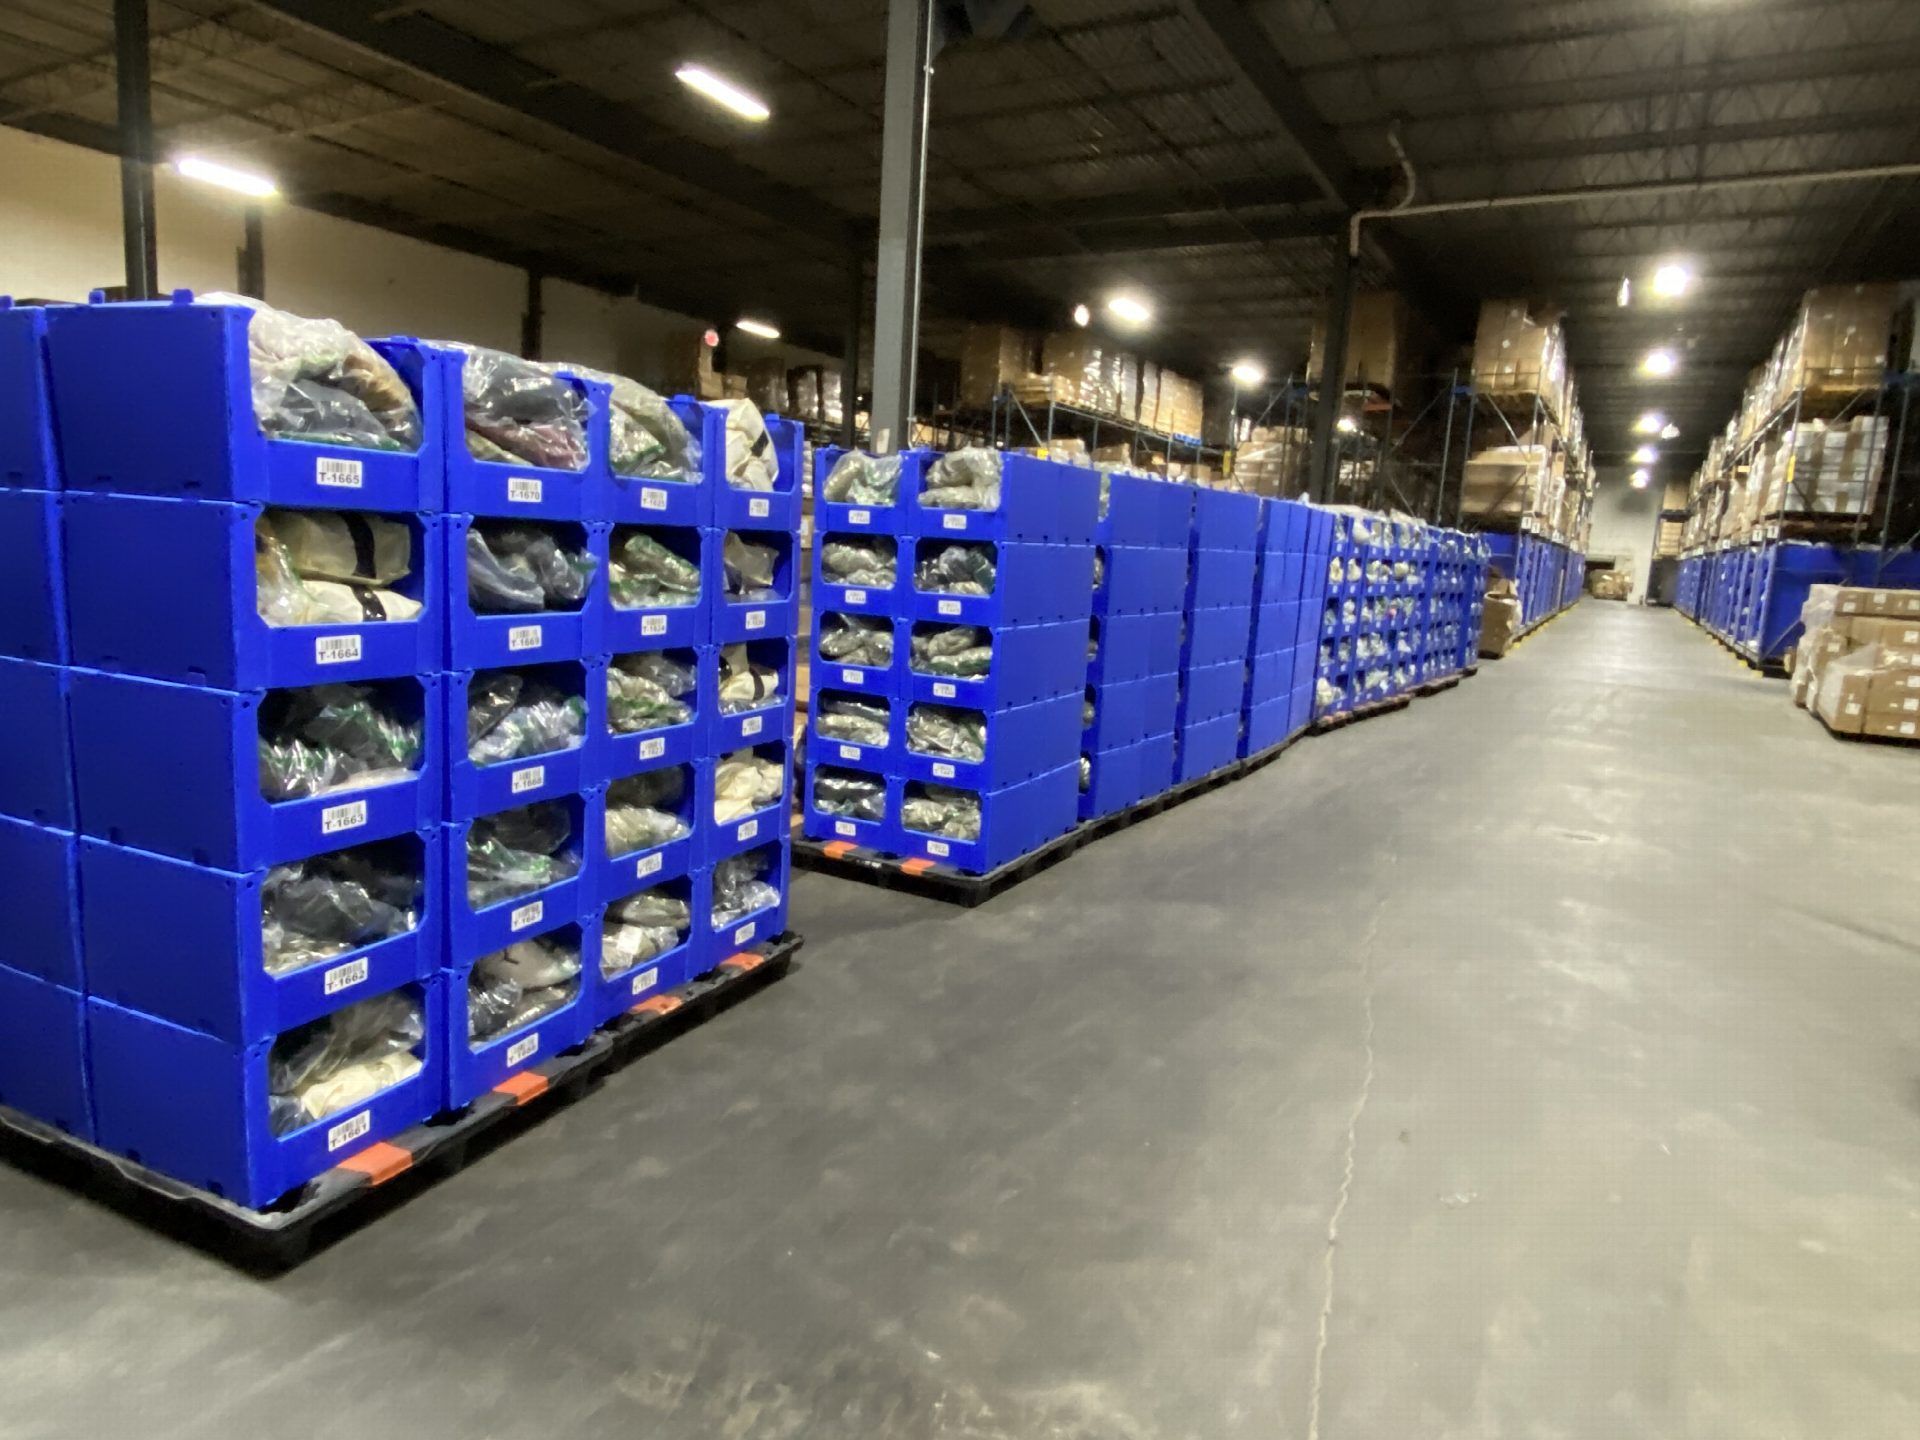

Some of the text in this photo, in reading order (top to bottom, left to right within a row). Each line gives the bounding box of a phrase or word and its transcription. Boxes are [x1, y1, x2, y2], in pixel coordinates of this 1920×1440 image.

[319, 472, 359, 484] T-1665
[510, 490, 540, 500] T-1670
[318, 648, 358, 660] T-1664
[325, 813, 363, 830] T-1663
[327, 970, 365, 991] T-1662
[330, 1123, 367, 1147] T-1661
